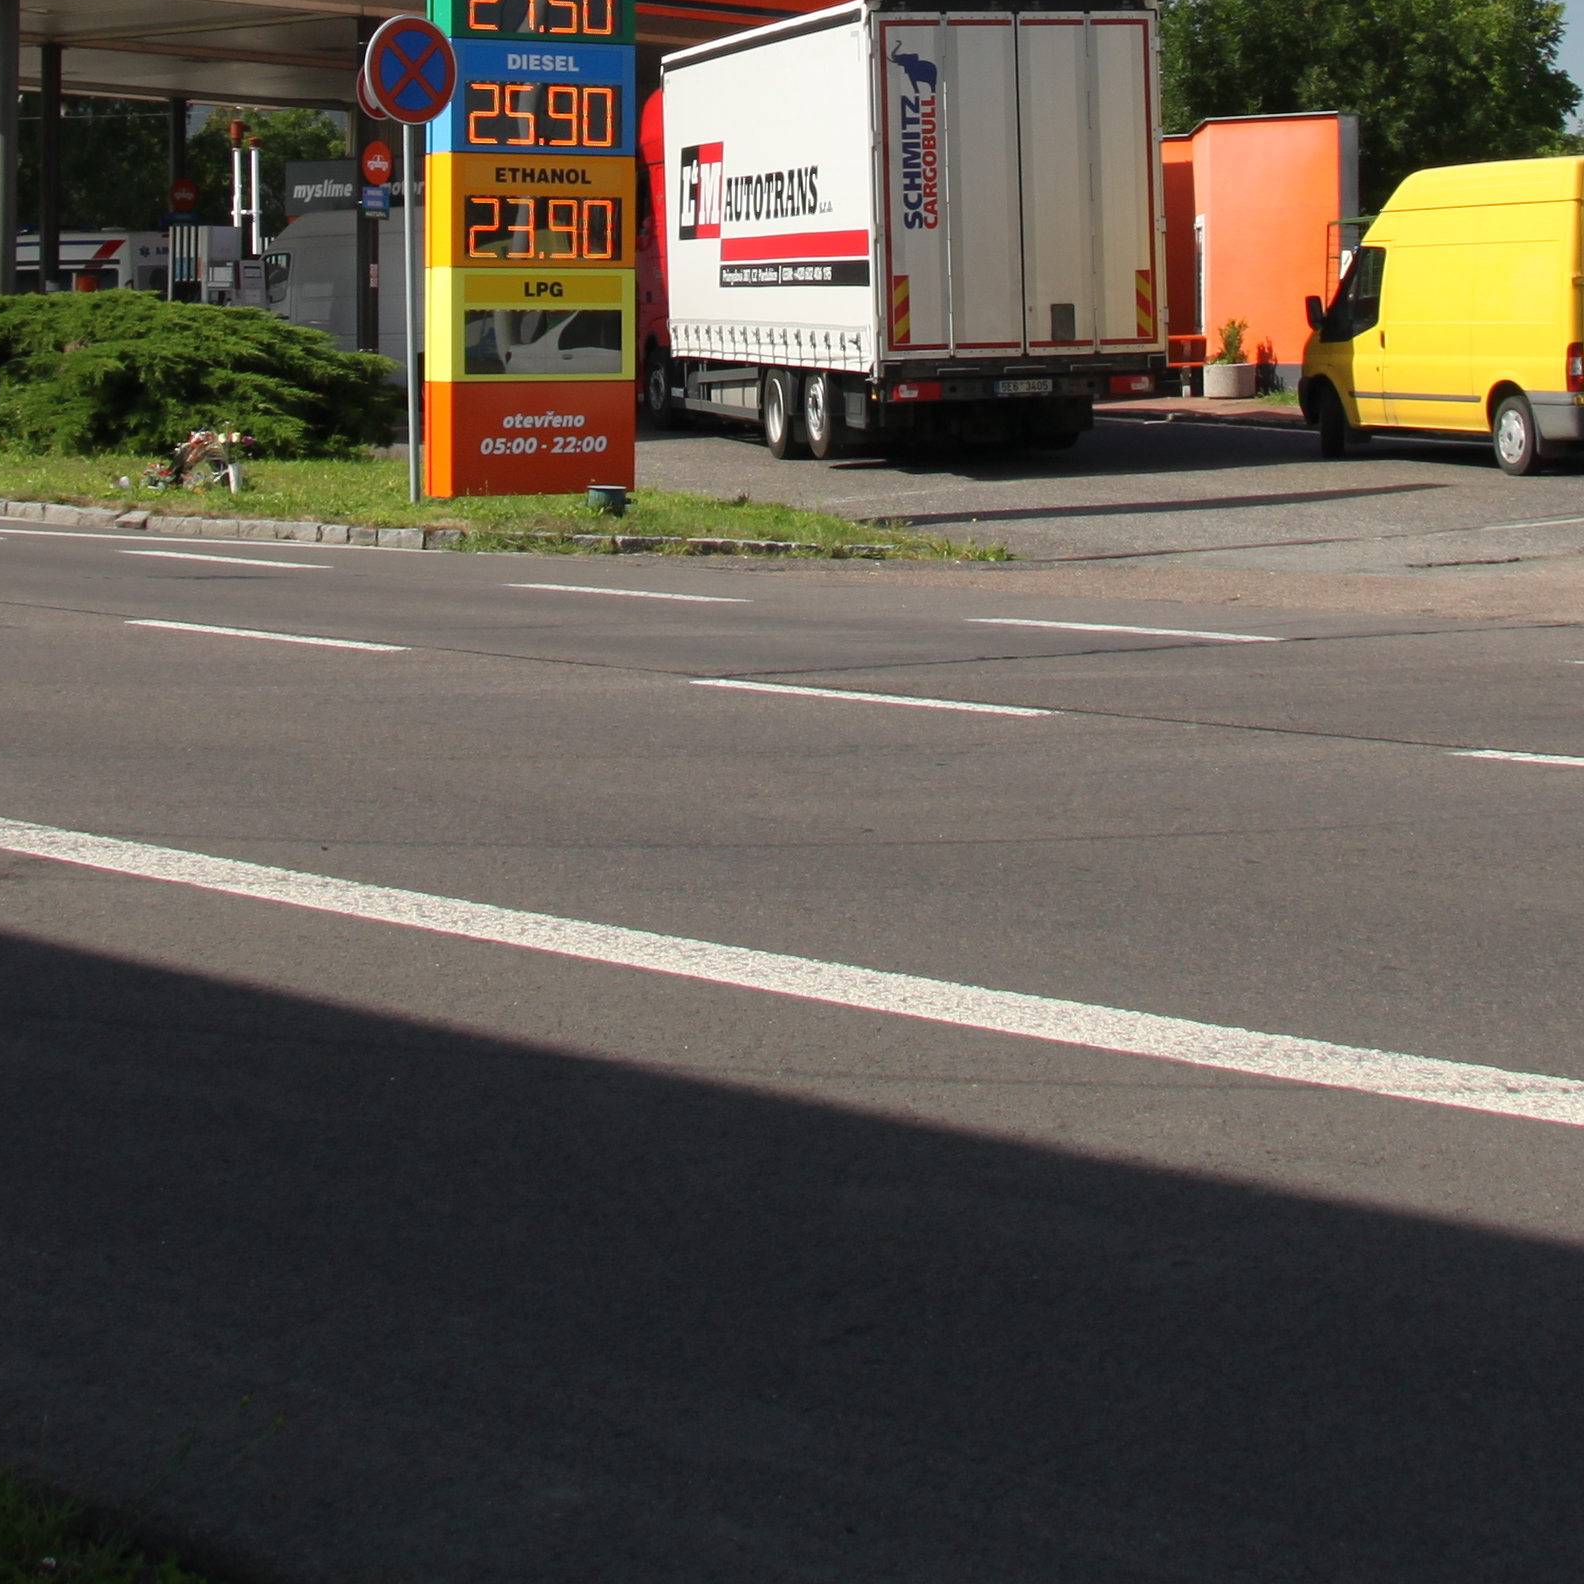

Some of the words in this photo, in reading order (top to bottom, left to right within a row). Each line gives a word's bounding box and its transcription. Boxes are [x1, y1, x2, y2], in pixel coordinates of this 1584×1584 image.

[506, 53, 580, 73] DIESEL
[469, 83, 613, 147] 25.90
[901, 95, 924, 229] SCHMITZ
[921, 96, 938, 229] CARGOBULL
[495, 167, 592, 185] ETHANOL
[292, 179, 353, 203] myslíme
[724, 165, 819, 222] AUTOTRANS
[469, 197, 613, 259] 23.90
[524, 282, 563, 297] LPG
[502, 411, 586, 428] otevřeno
[480, 437, 538, 455] 05:00
[550, 435, 608, 453] 22:00
